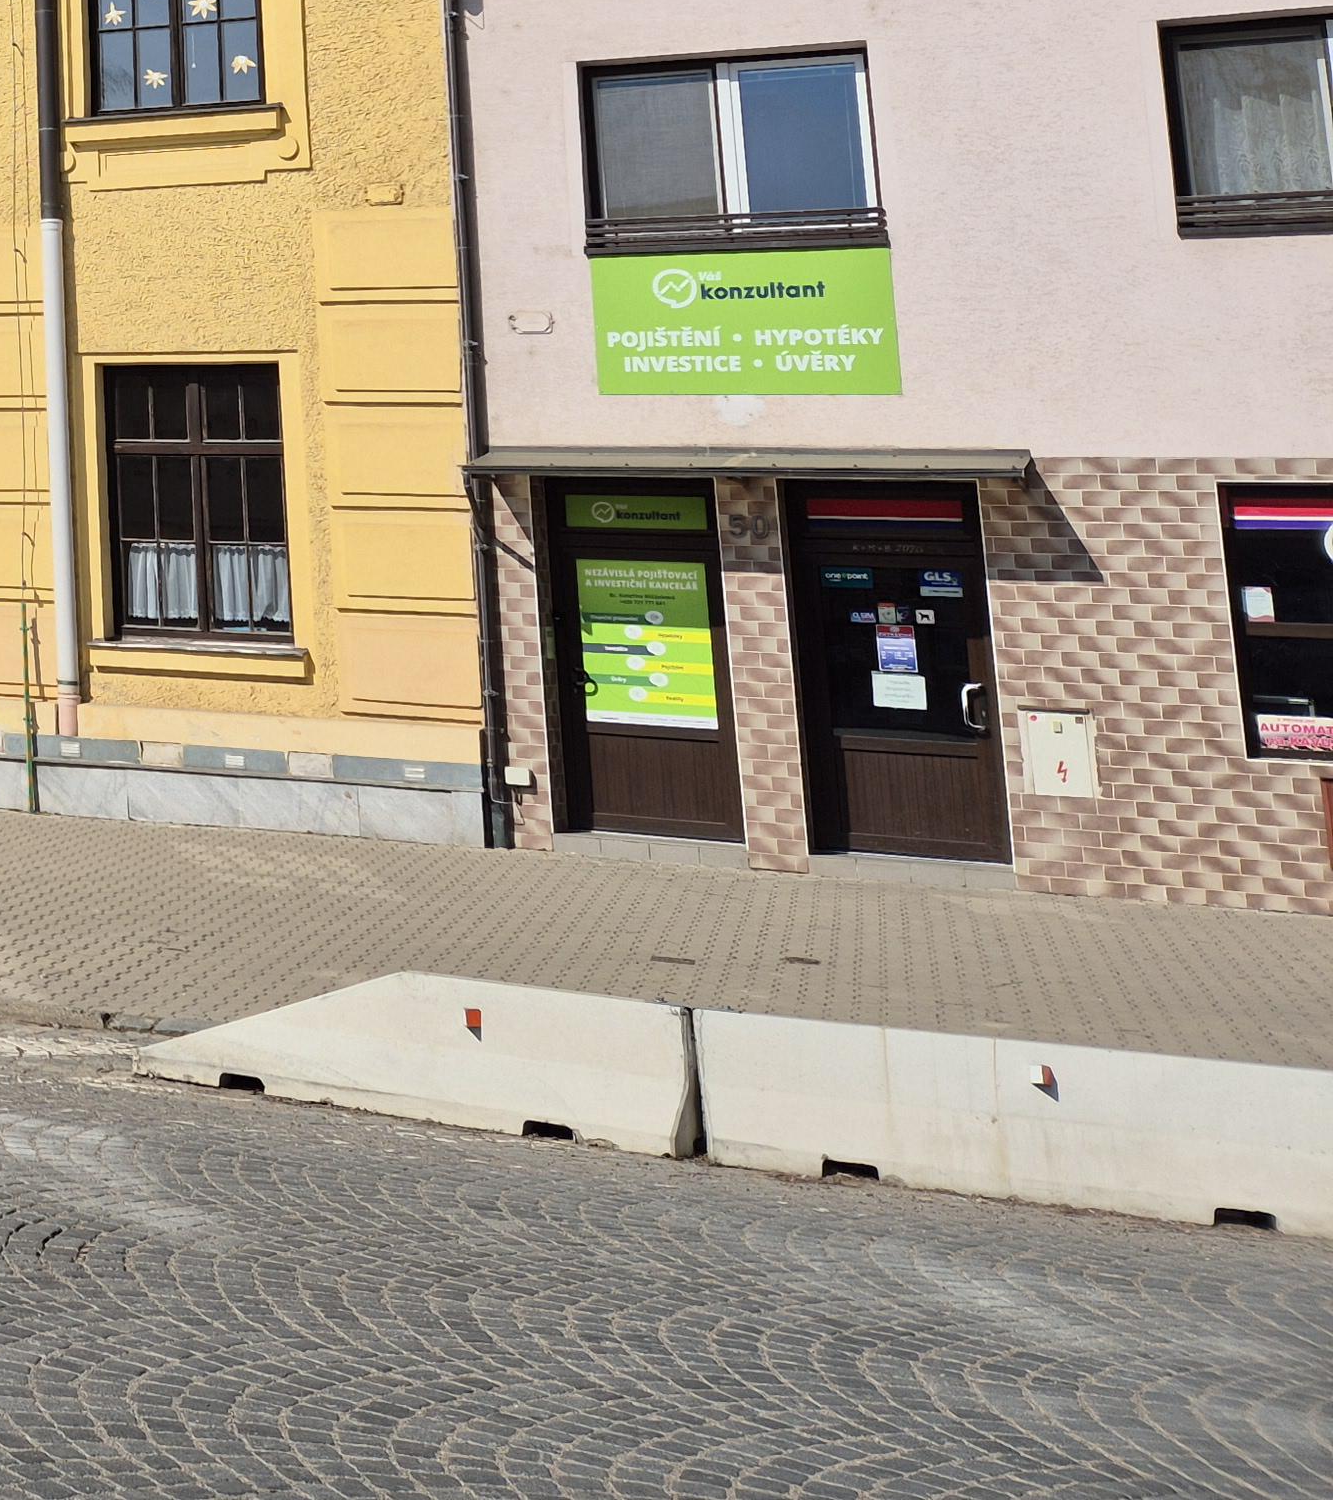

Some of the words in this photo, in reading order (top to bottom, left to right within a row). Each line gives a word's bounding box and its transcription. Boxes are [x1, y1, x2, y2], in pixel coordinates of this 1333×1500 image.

[700, 281, 826, 300] konzultant
[606, 326, 722, 351] POJIŠTĚNÍ
[754, 324, 884, 346] HYPOTÉKY
[623, 355, 742, 373] INVESTICE
[775, 351, 856, 372] ÚVĚRY
[615, 510, 681, 521] konzultant
[729, 514, 770, 540] 50
[585, 568, 635, 578] NEZÁVISLÁ
[638, 569, 697, 580] POJIŠŤOVACÍ
[923, 571, 951, 582] GLS
[585, 579, 592, 587] A
[595, 578, 646, 589] INVESTIČNÍ
[649, 579, 698, 590] KANCELÁŘ
[1260, 723, 1333, 735] AUTOMAT
